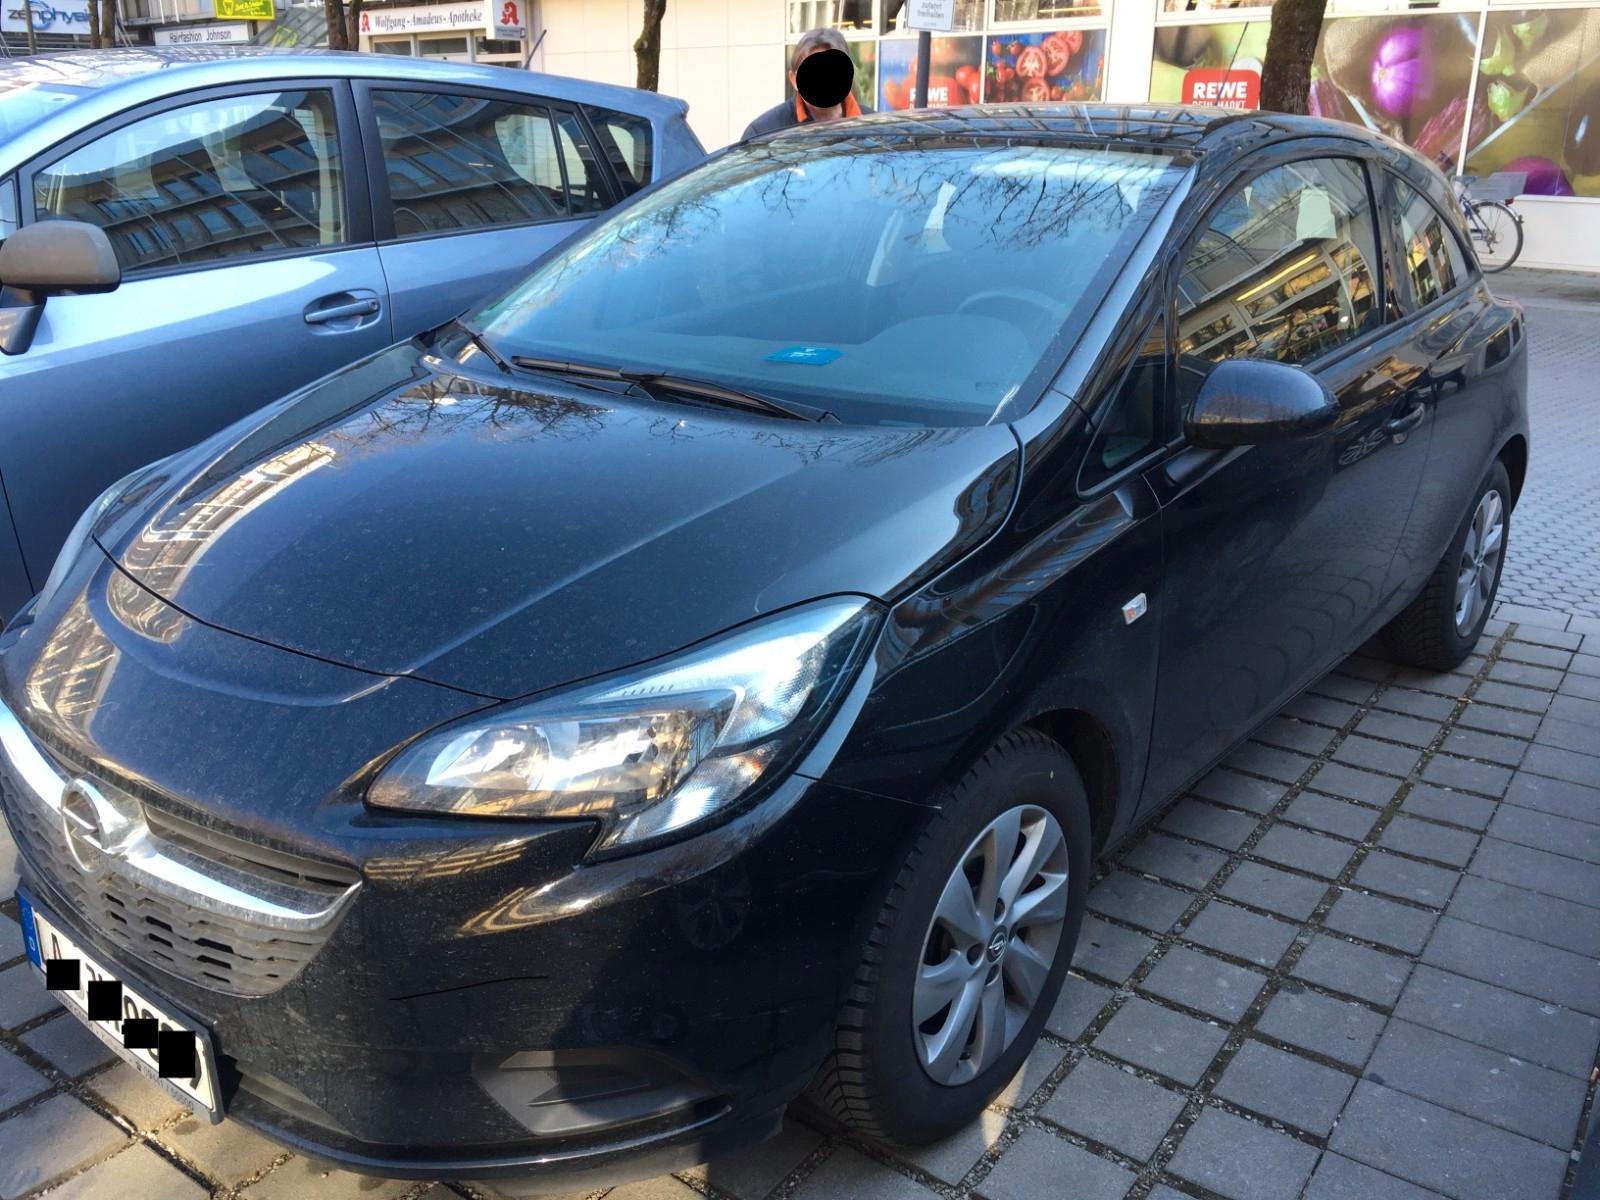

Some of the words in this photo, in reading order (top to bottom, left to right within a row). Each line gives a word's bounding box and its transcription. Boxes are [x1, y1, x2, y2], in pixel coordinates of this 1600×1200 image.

[169, 32, 202, 43] Hairfashion
[206, 30, 232, 41] Johnson
[909, 87, 948, 102] RWE
[1193, 81, 1248, 99] REWE
